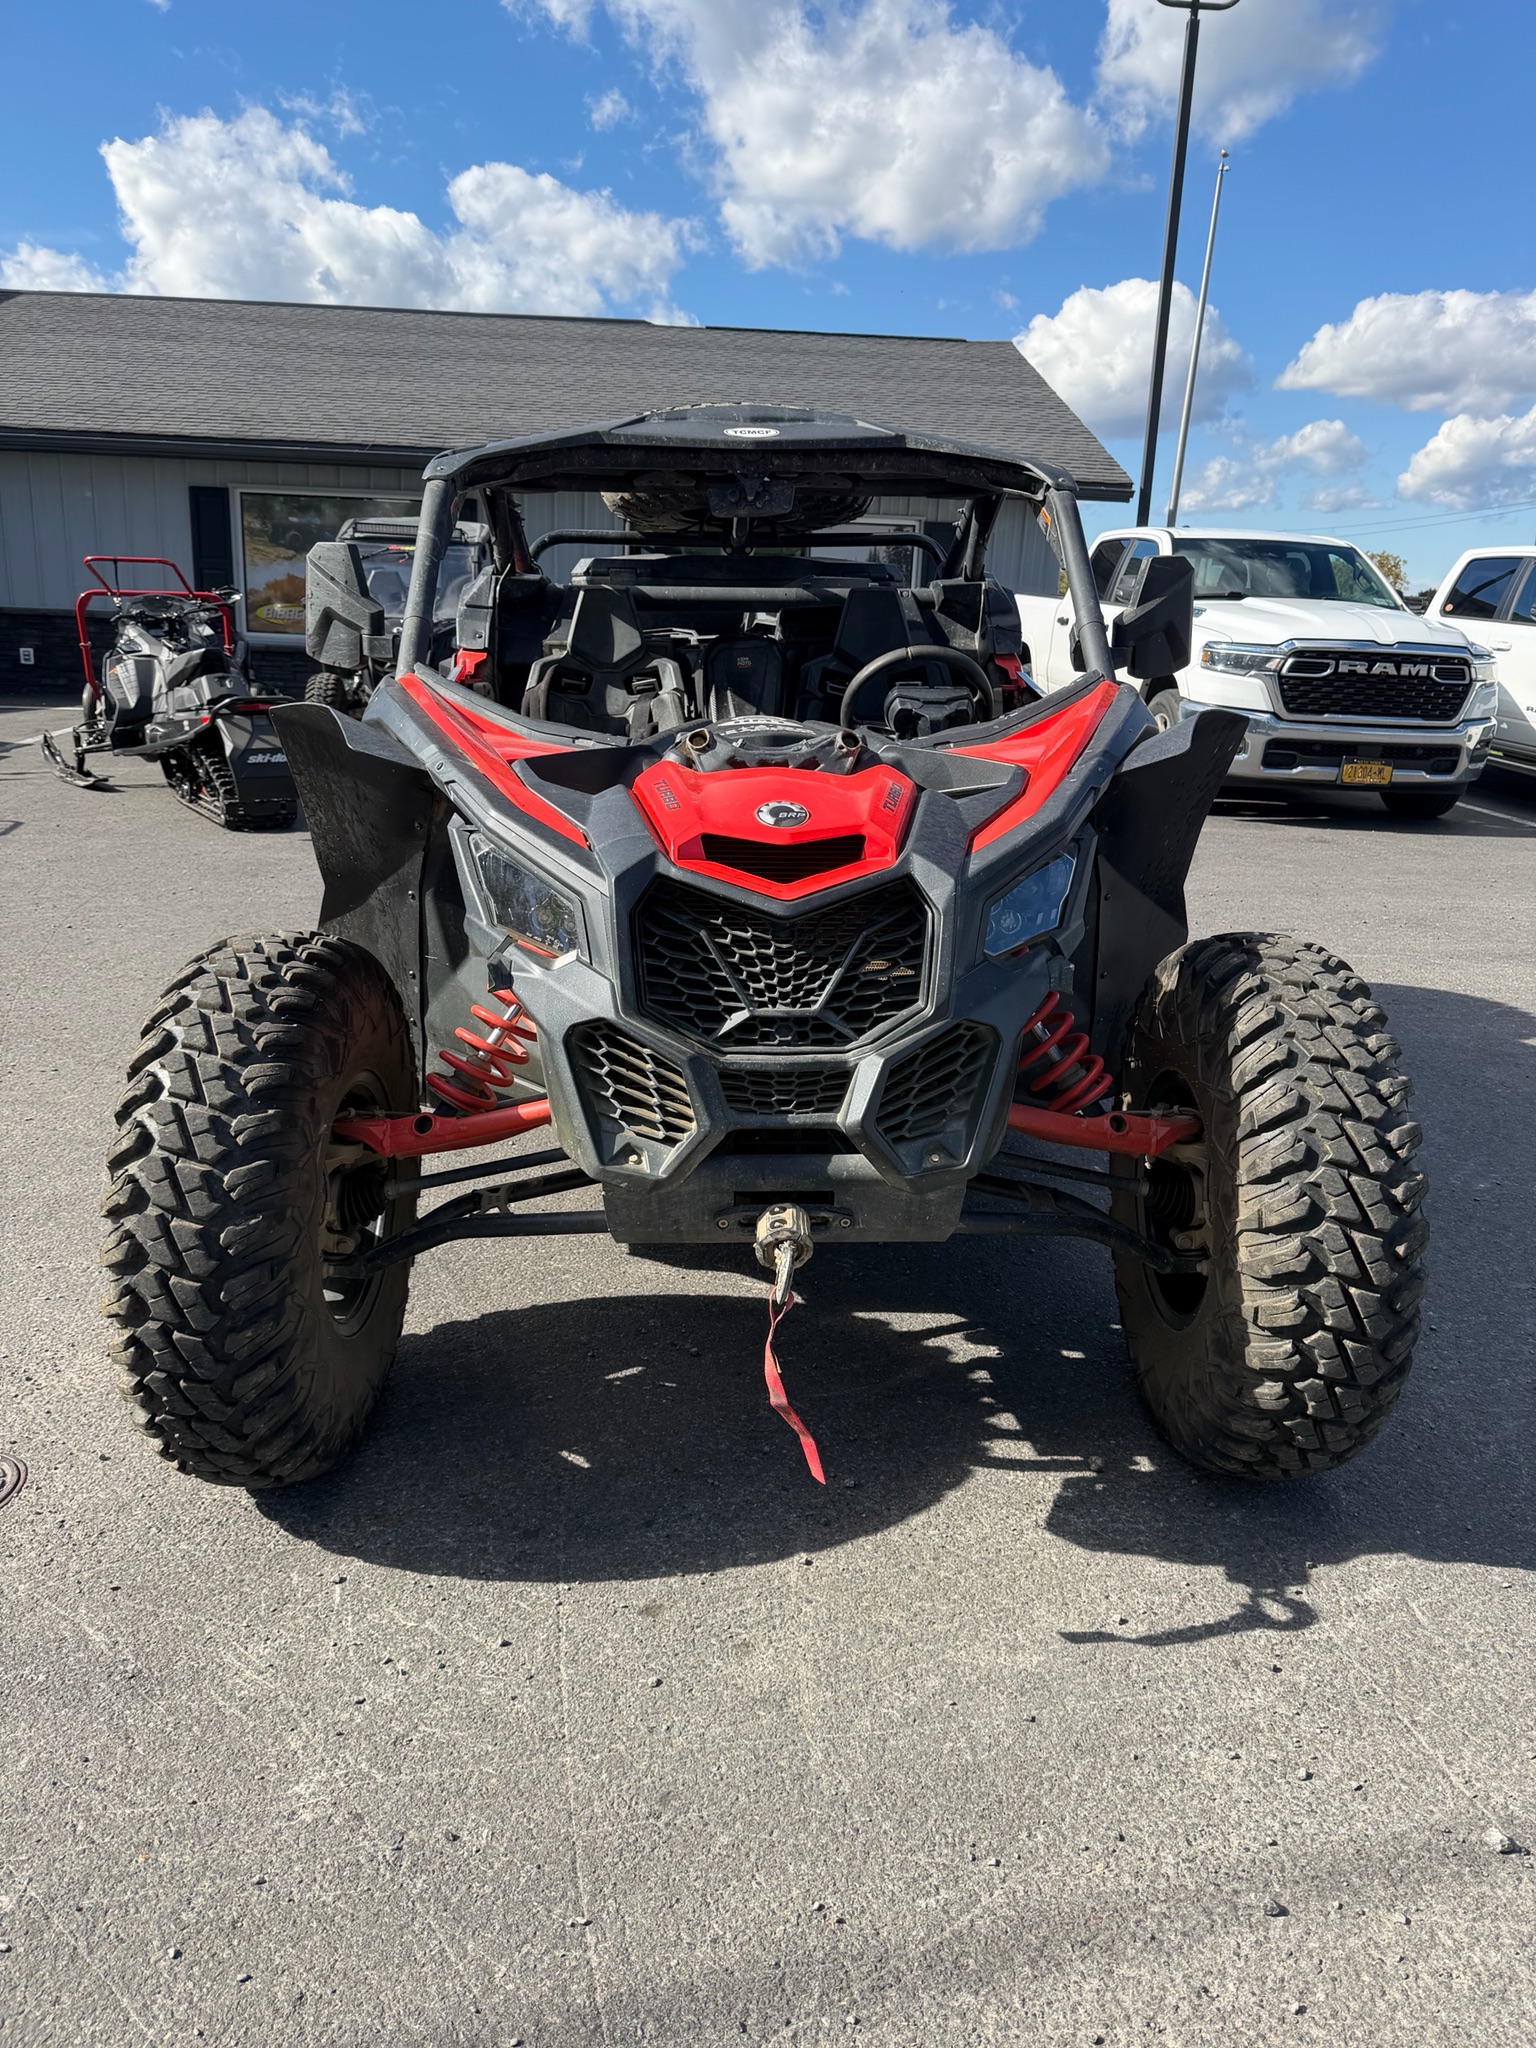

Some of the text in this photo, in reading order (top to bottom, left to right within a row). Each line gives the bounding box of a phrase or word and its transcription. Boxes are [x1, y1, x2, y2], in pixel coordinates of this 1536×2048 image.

[1338, 659, 1429, 676] RAM
[247, 752, 288, 764] ski-do
[653, 779, 681, 810] TURBO
[882, 782, 903, 813] TURBO
[778, 811, 806, 819] BRP
